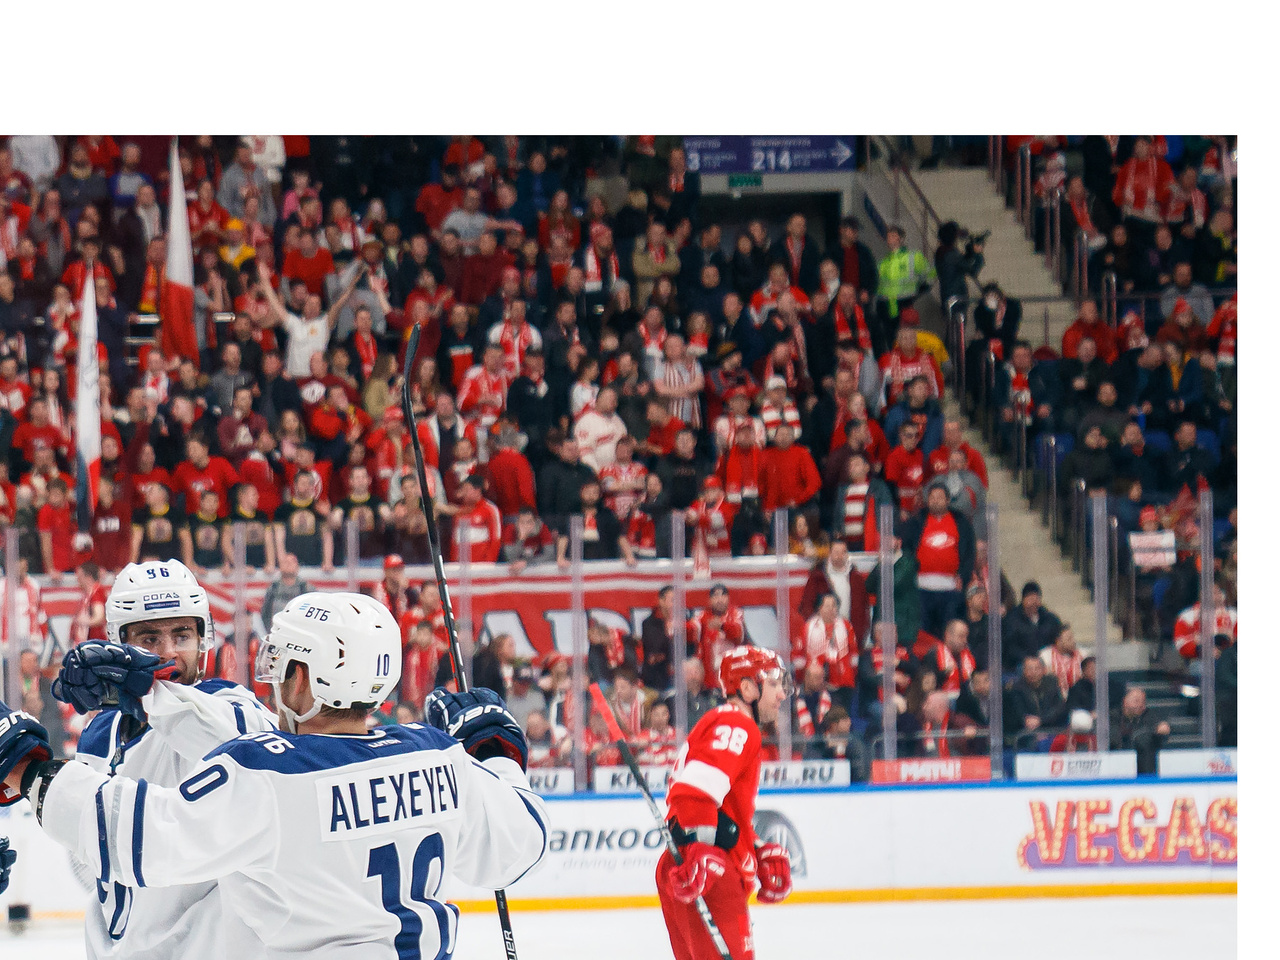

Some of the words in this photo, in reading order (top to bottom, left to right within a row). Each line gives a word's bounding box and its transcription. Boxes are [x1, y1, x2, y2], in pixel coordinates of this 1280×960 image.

[751, 151, 792, 171] 214
[143, 592, 180, 602] СОГАЗ
[305, 606, 331, 622] ВТБ
[286, 643, 312, 653] CCM
[377, 654, 389, 676] 10
[712, 725, 748, 755] 38
[330, 763, 459, 832] ALEXEYEV
[1030, 798, 1237, 864] VEGAS
